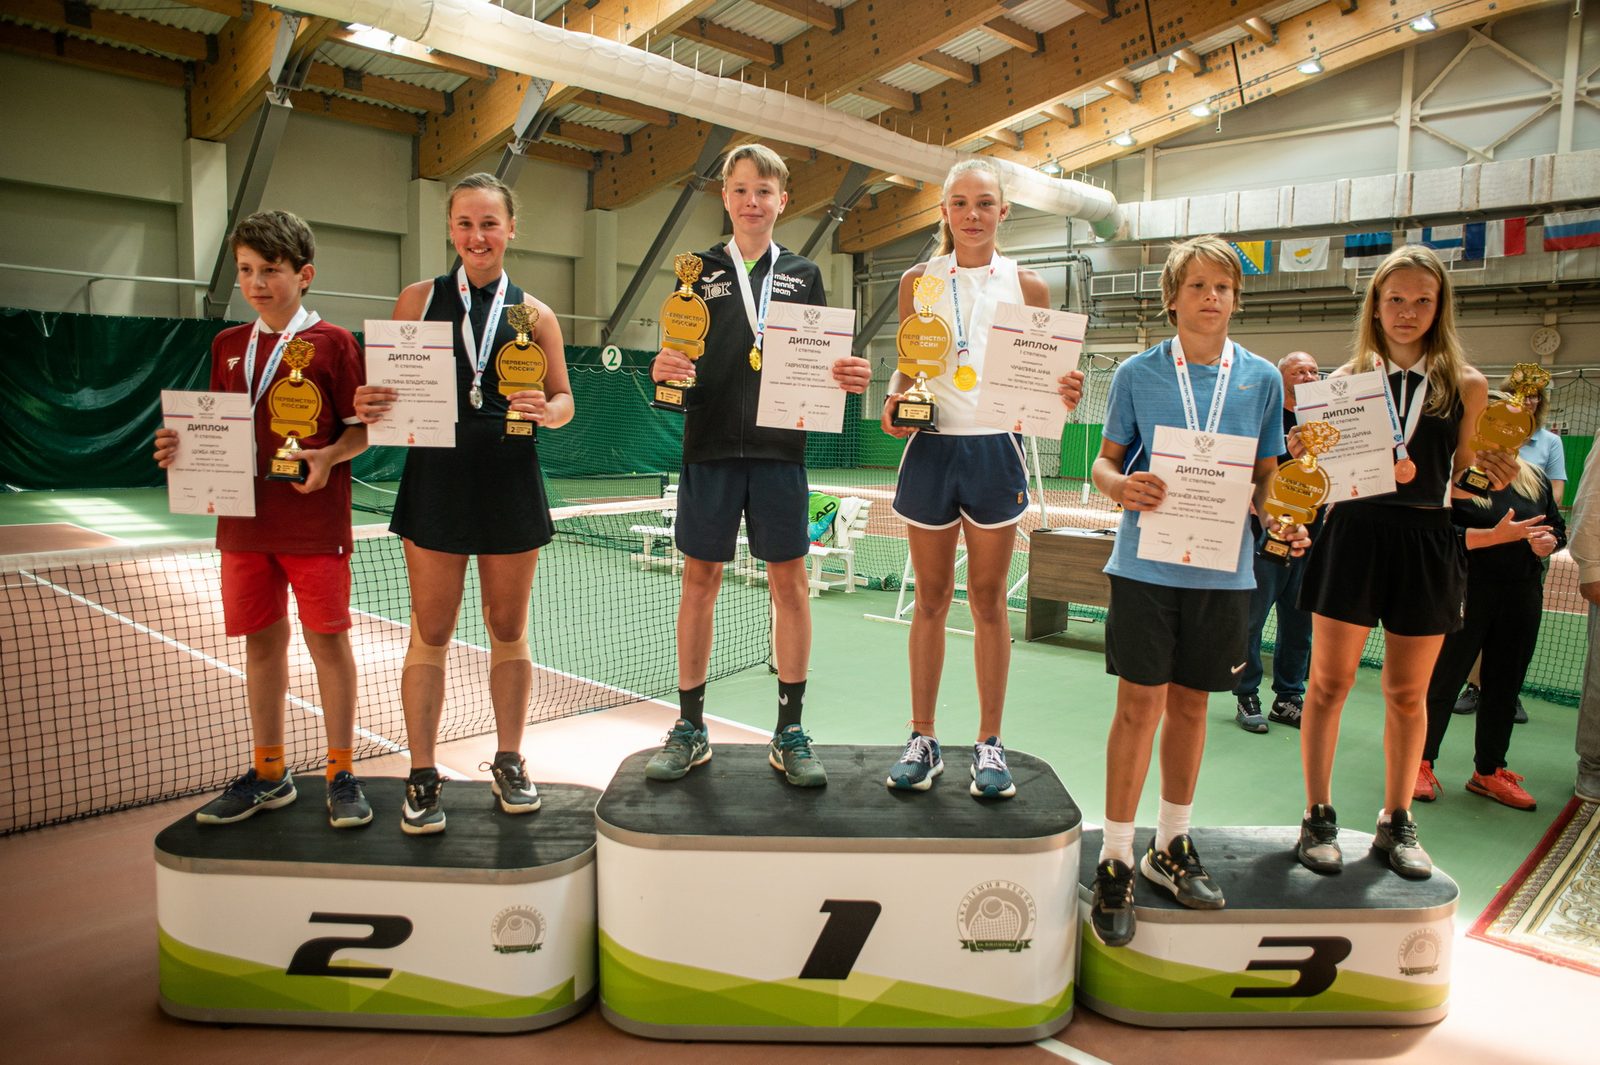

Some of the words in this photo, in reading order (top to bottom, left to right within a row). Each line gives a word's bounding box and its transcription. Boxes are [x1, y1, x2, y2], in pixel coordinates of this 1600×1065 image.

[773, 287, 791, 296] team
[789, 337, 830, 347] ДИПЛОМ
[903, 334, 946, 342] ПЕРВЕНСТВО
[1014, 339, 1057, 352] ДИПЛОМ
[608, 349, 617, 366] 2
[275, 396, 316, 404] ПЕРВЕНСТВО
[1322, 406, 1364, 420] ДИПЛОМ
[187, 424, 229, 432] ДИПЛОМ
[1175, 465, 1225, 478] ДИПЛОМ
[285, 912, 412, 978] 2
[799, 901, 881, 980] 1
[1230, 938, 1352, 998] 3
